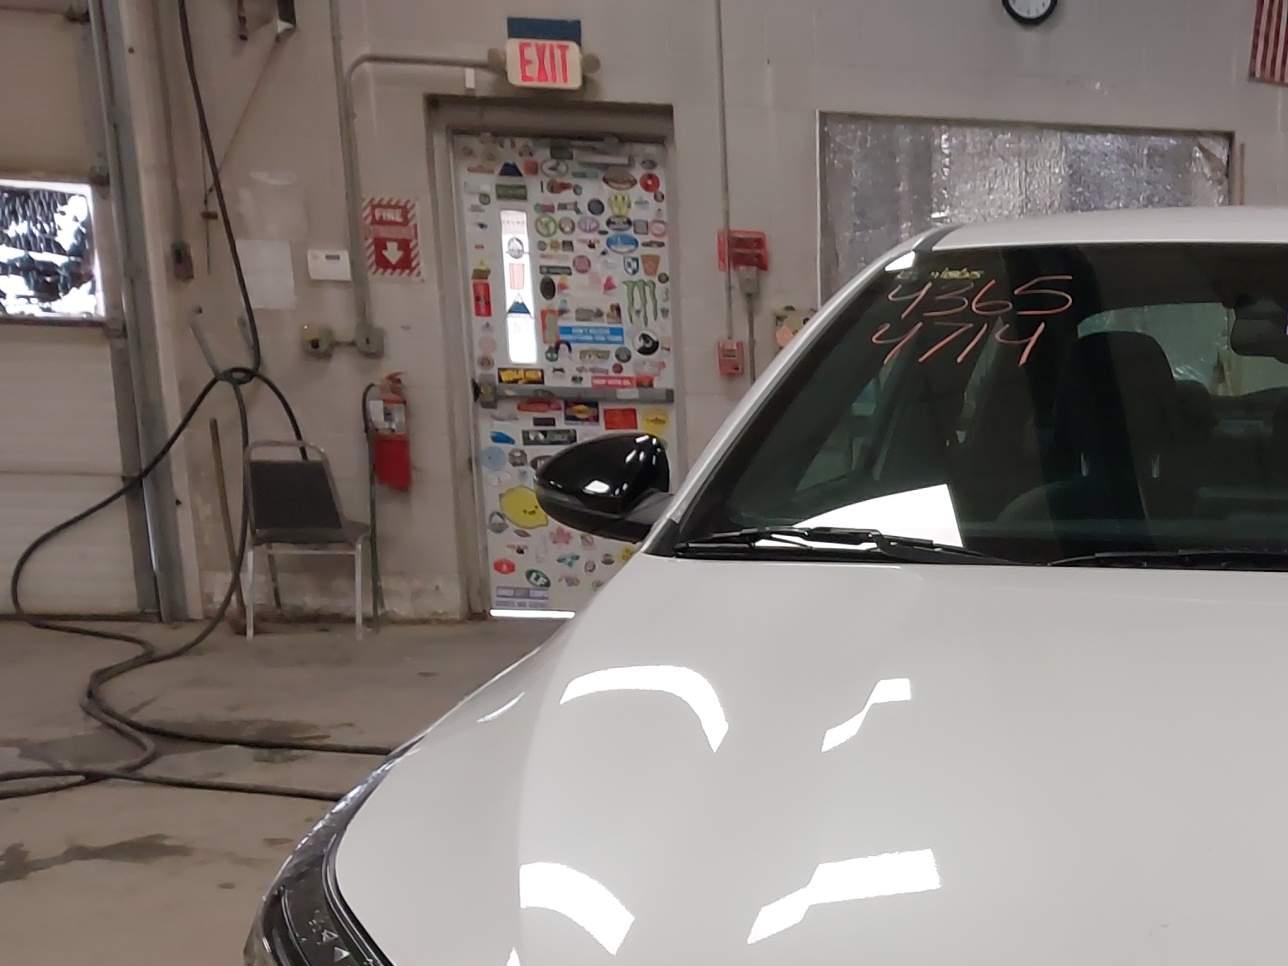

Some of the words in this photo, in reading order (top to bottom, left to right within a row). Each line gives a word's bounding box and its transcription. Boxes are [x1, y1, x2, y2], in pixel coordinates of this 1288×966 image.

[518, 42, 570, 83] EXIT
[887, 275, 1073, 319] 4365
[871, 321, 1046, 367] 4714
